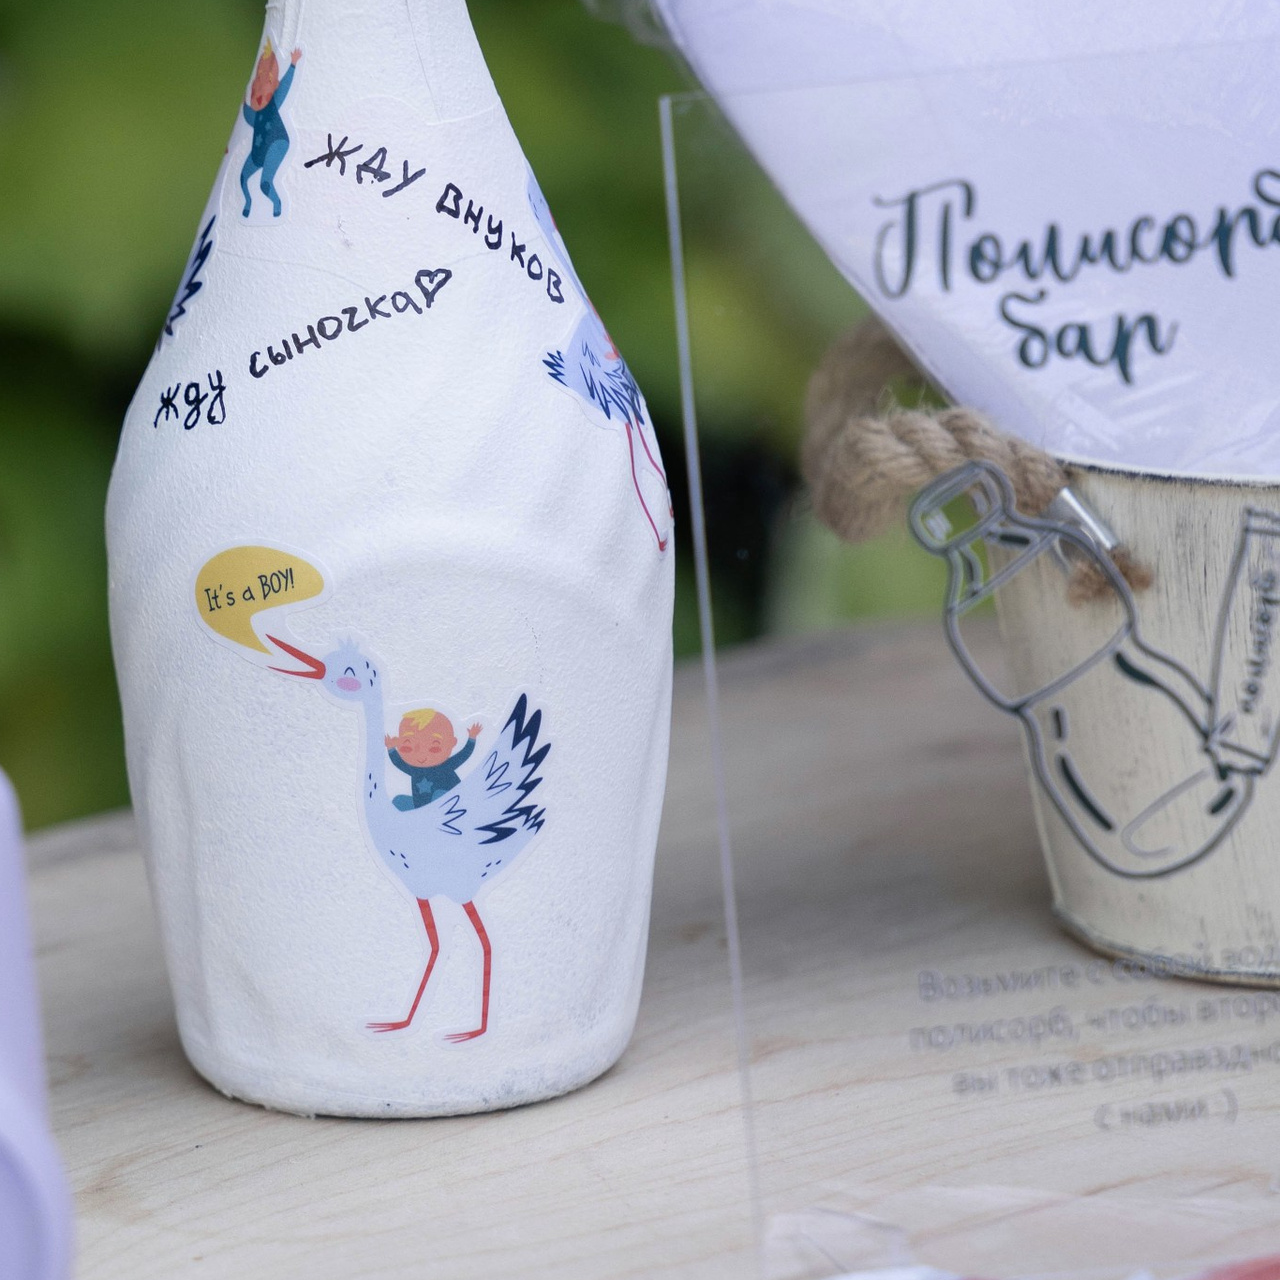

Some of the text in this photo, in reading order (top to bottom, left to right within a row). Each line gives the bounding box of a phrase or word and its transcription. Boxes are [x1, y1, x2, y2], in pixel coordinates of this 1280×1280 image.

[999, 289, 1179, 386] бар
[204, 567, 295, 612] It's a BOY!
